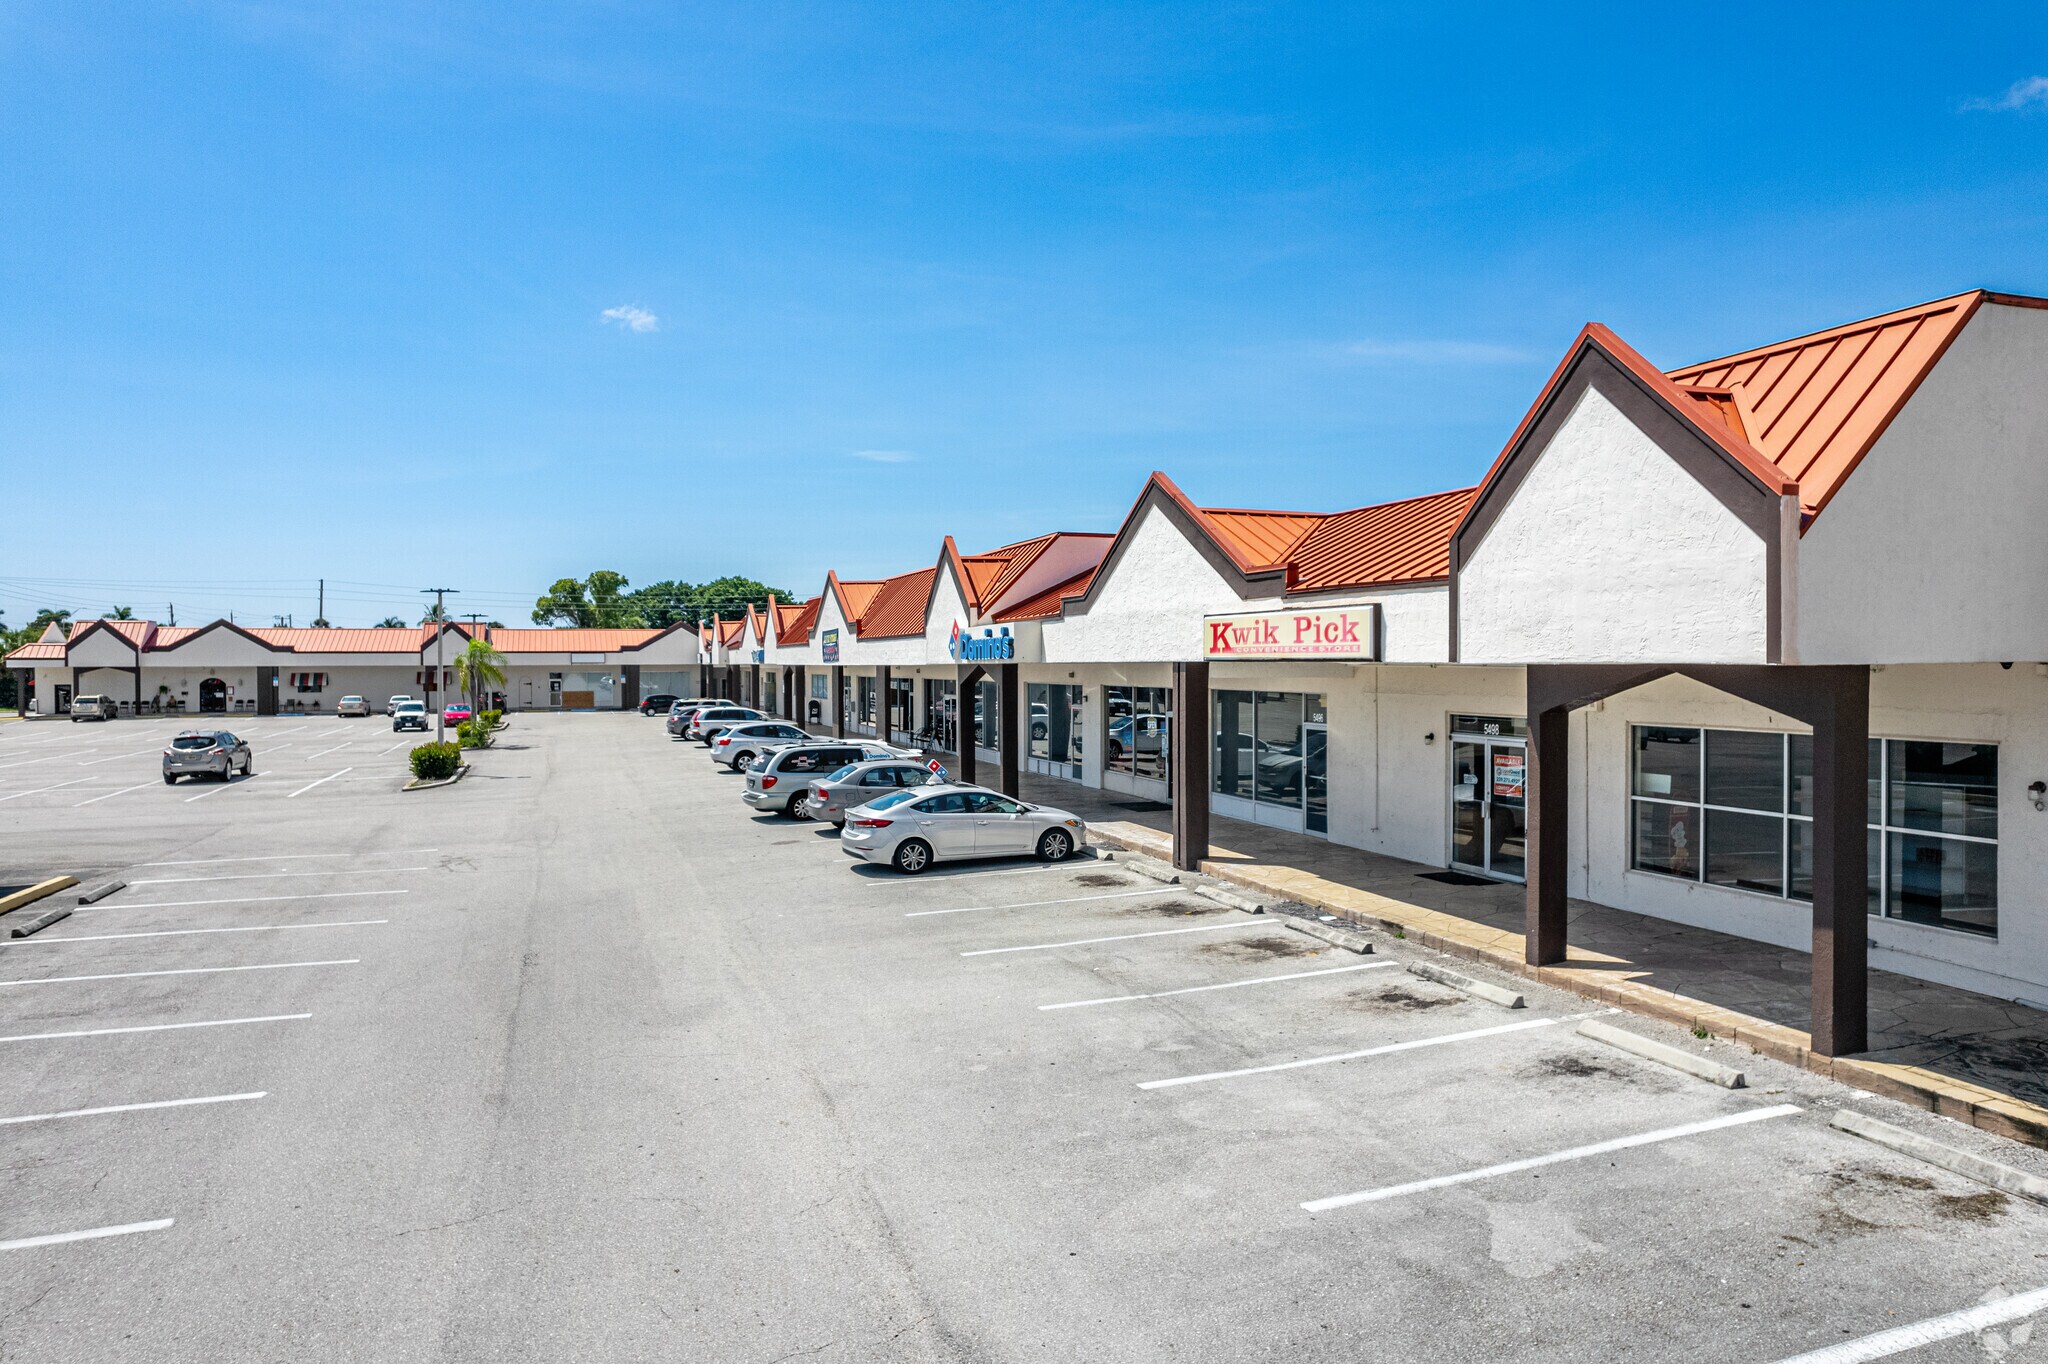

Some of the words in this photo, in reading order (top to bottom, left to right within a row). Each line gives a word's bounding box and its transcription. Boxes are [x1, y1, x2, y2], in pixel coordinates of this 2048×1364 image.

[960, 627, 1013, 660] Domino's
[1209, 619, 1280, 654] Kwik
[1293, 614, 1360, 644] Pick
[1236, 645, 1314, 653] CONVENIENCE
[1319, 644, 1360, 652] STORE
[1484, 723, 1500, 735] 5498
